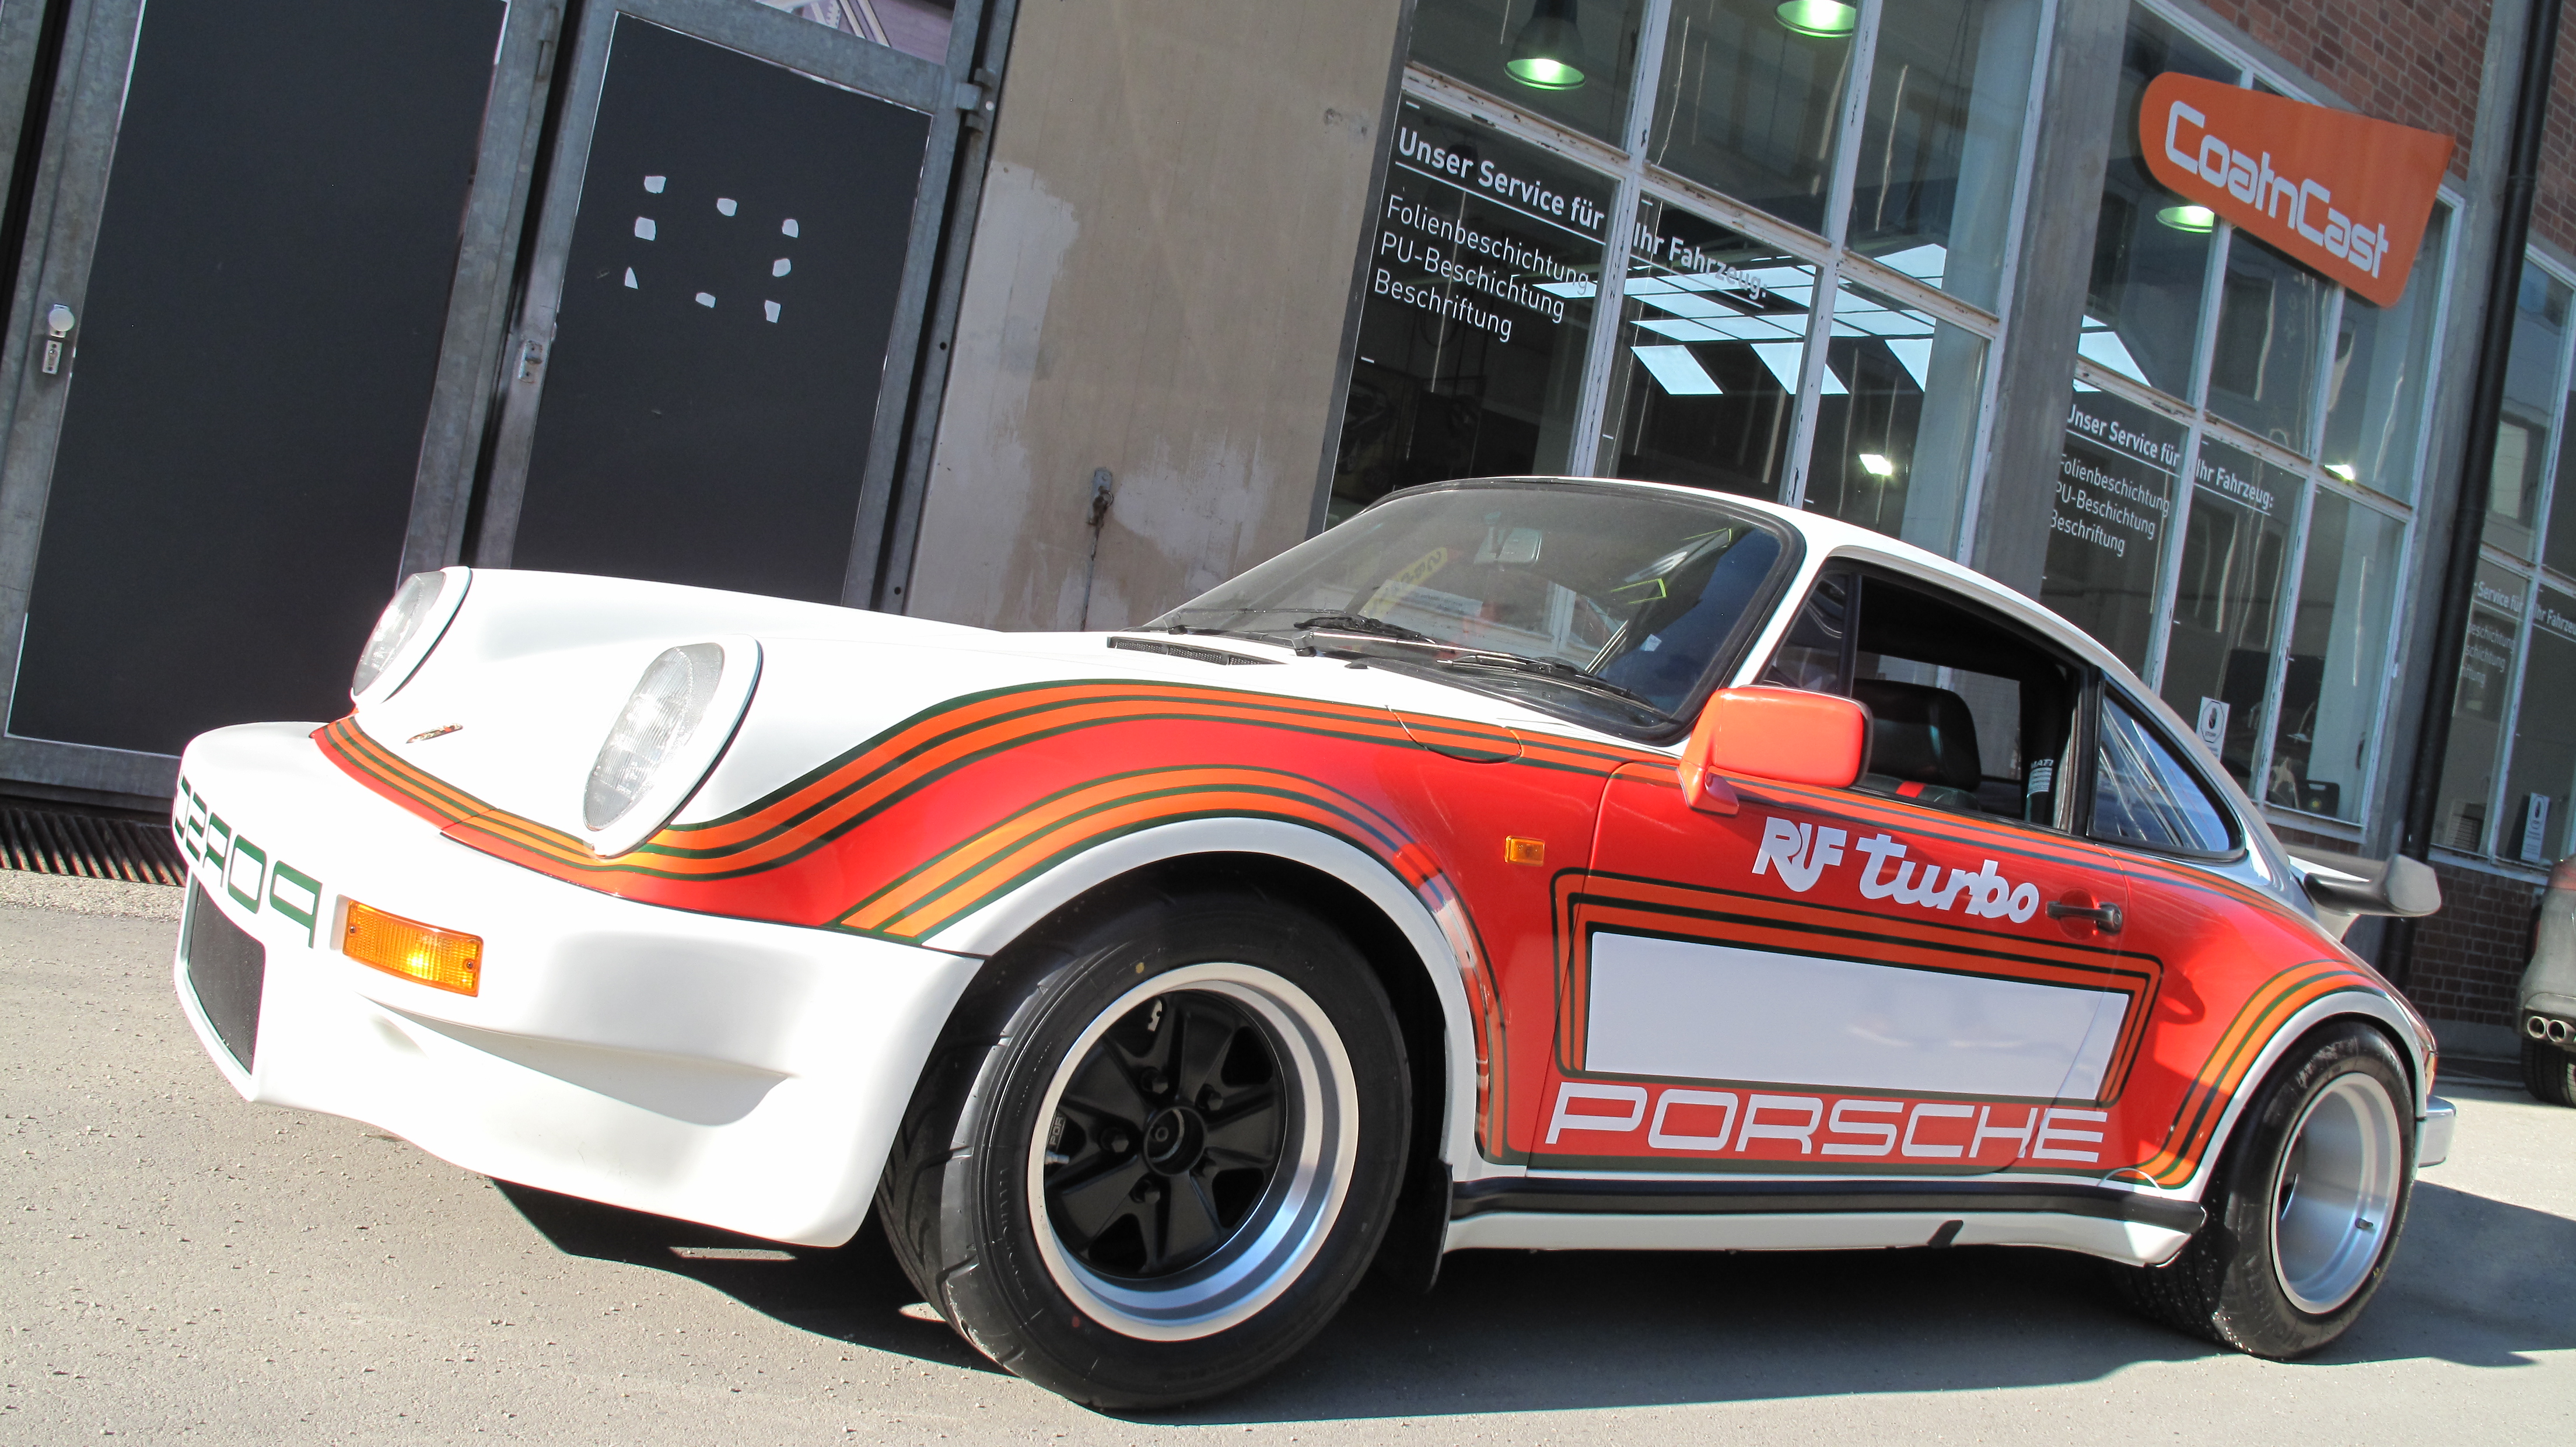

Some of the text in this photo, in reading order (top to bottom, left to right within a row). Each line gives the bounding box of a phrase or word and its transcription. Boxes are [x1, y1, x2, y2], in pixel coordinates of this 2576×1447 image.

[1398, 127, 1769, 299] Unser Service für Ihr Fahrzeug:
[2165, 100, 2389, 279] CoatnCast
[1380, 231, 1566, 324] PU-Beschichtung
[1387, 194, 1591, 296] Folienbeschichtung
[1374, 269, 1512, 343] Beschriftung
[2109, 421, 2158, 460] Service
[2161, 443, 2180, 467] für
[2195, 458, 2214, 483] Ihr
[2216, 467, 2275, 508] Fahrzeug:
[2477, 581, 2509, 608] Service
[2547, 609, 2576, 636] Fahrzeu
[1856, 833, 2040, 924] turbo
[1544, 1081, 2108, 1164] PORSCHE
